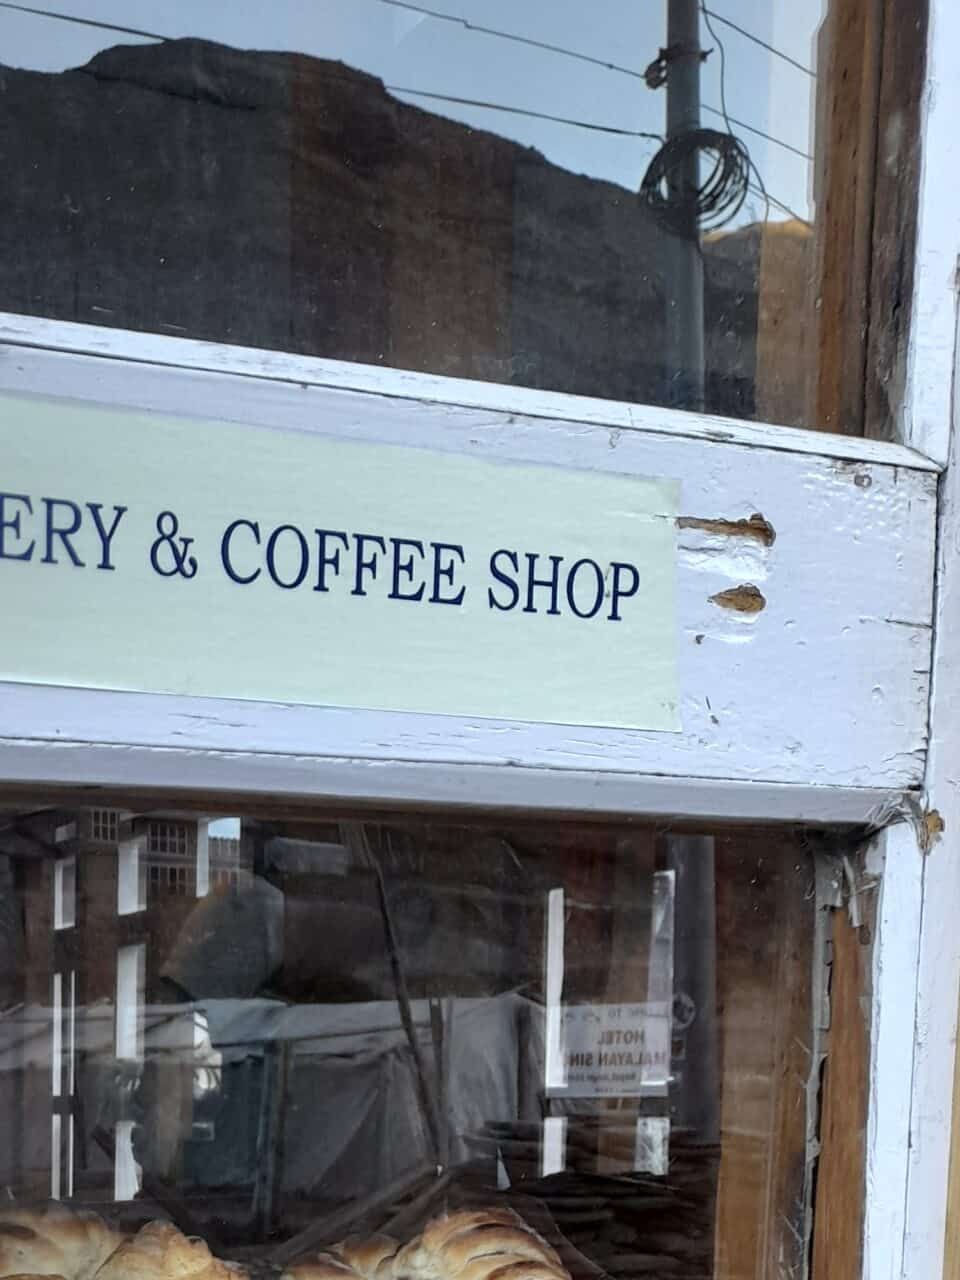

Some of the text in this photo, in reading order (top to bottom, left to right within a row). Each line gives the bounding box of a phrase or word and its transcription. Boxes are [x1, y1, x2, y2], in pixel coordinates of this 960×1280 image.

[149, 510, 199, 580] &
[220, 518, 468, 607] COFFEE
[487, 548, 641, 622] SHOP
